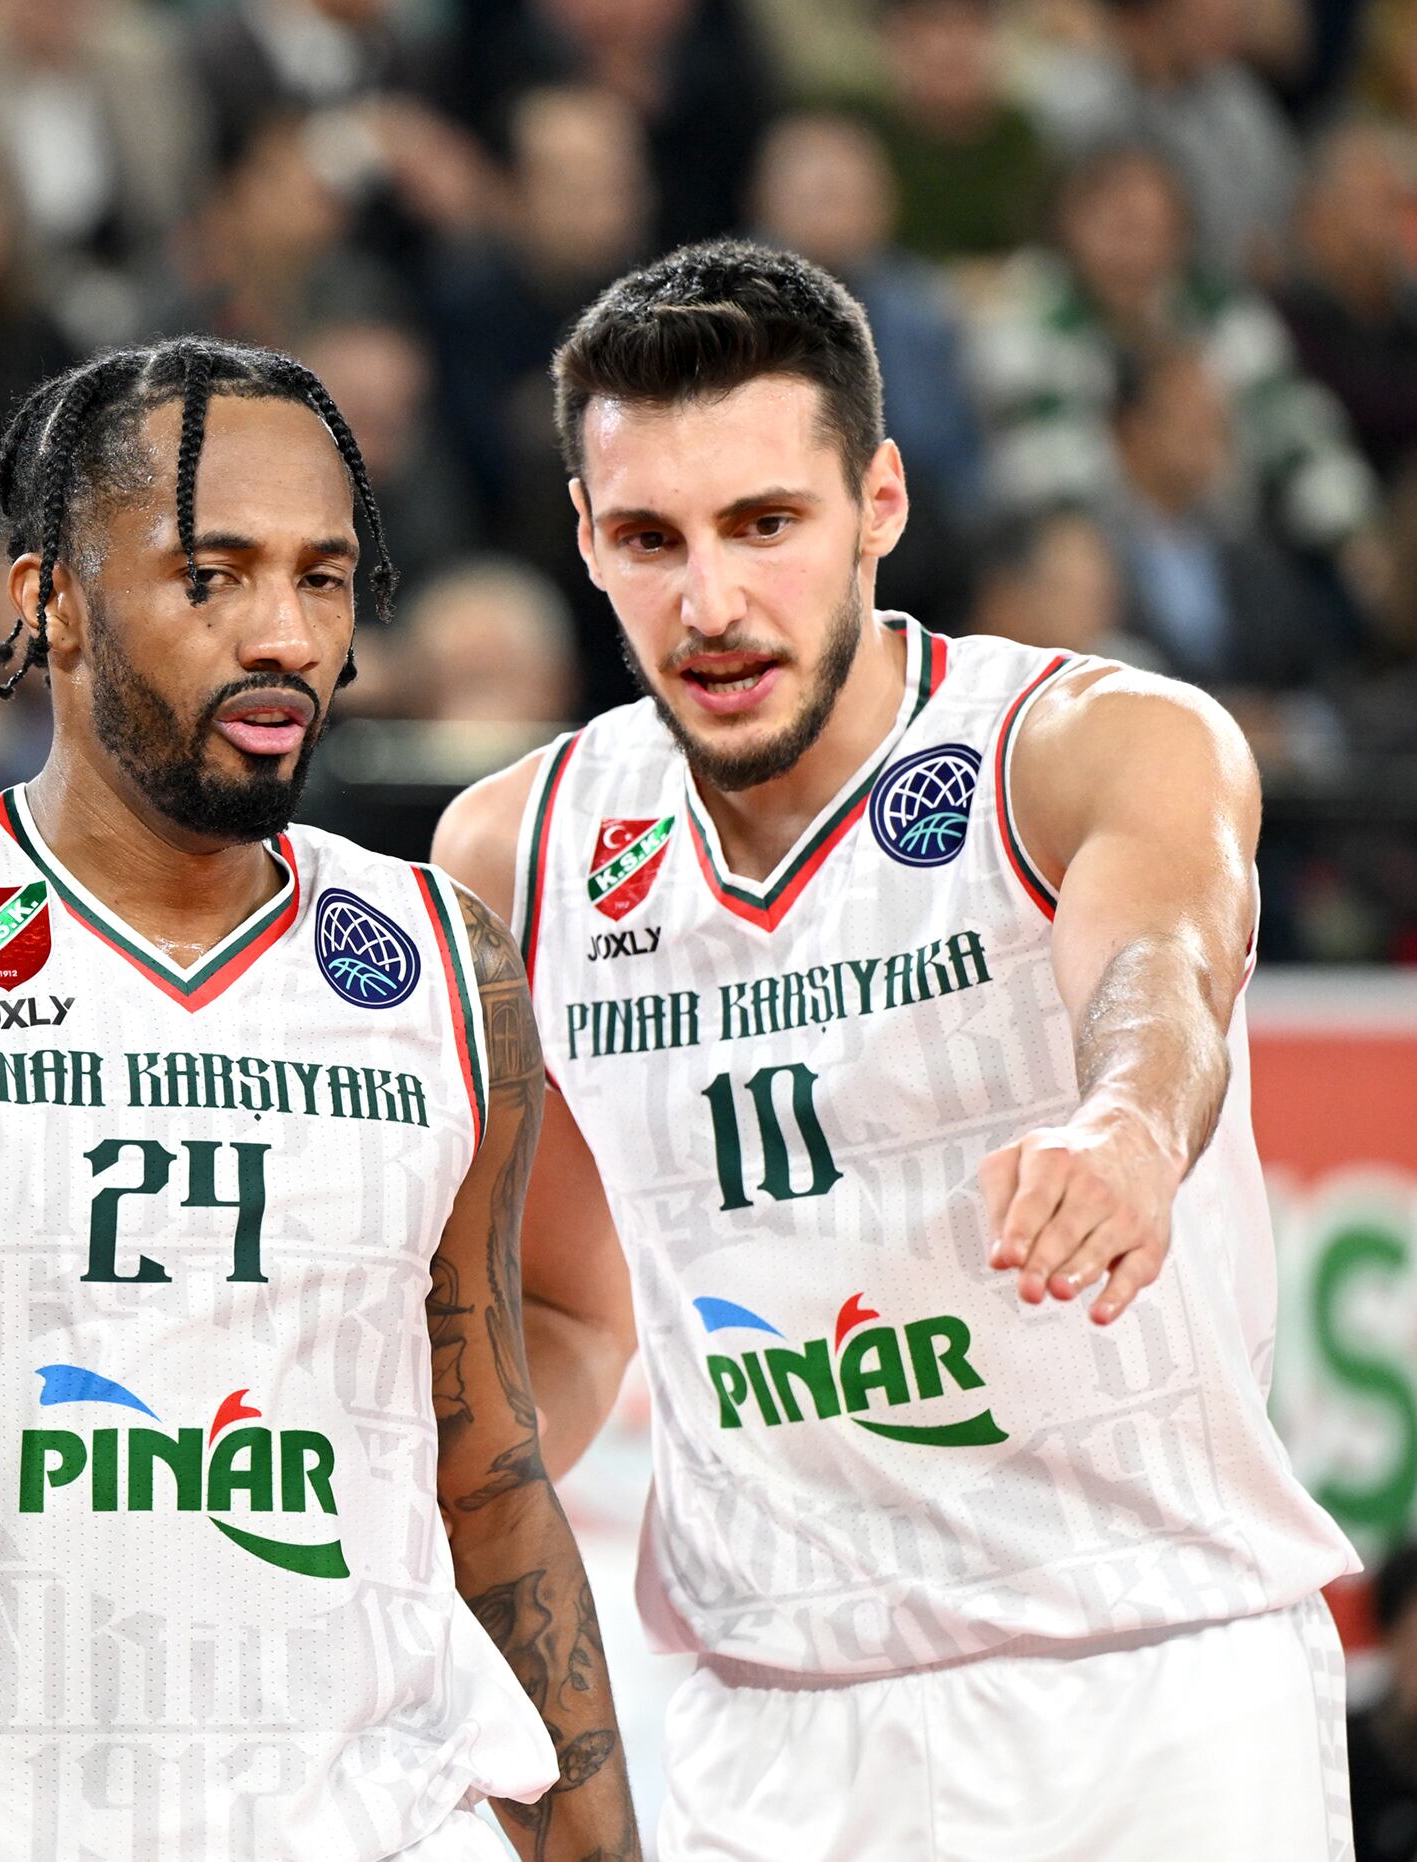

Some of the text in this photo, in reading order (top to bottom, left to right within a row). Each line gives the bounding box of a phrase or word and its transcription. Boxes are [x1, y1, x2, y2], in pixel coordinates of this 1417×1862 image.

[594, 830, 668, 893] K.S.K.
[587, 926, 661, 962] JOXLY
[566, 990, 700, 1060] PINAR
[700, 1062, 844, 1212] 10
[79, 1138, 272, 1284] 24
[706, 1314, 987, 1429] PINAR
[18, 1426, 339, 1516] PINAR
